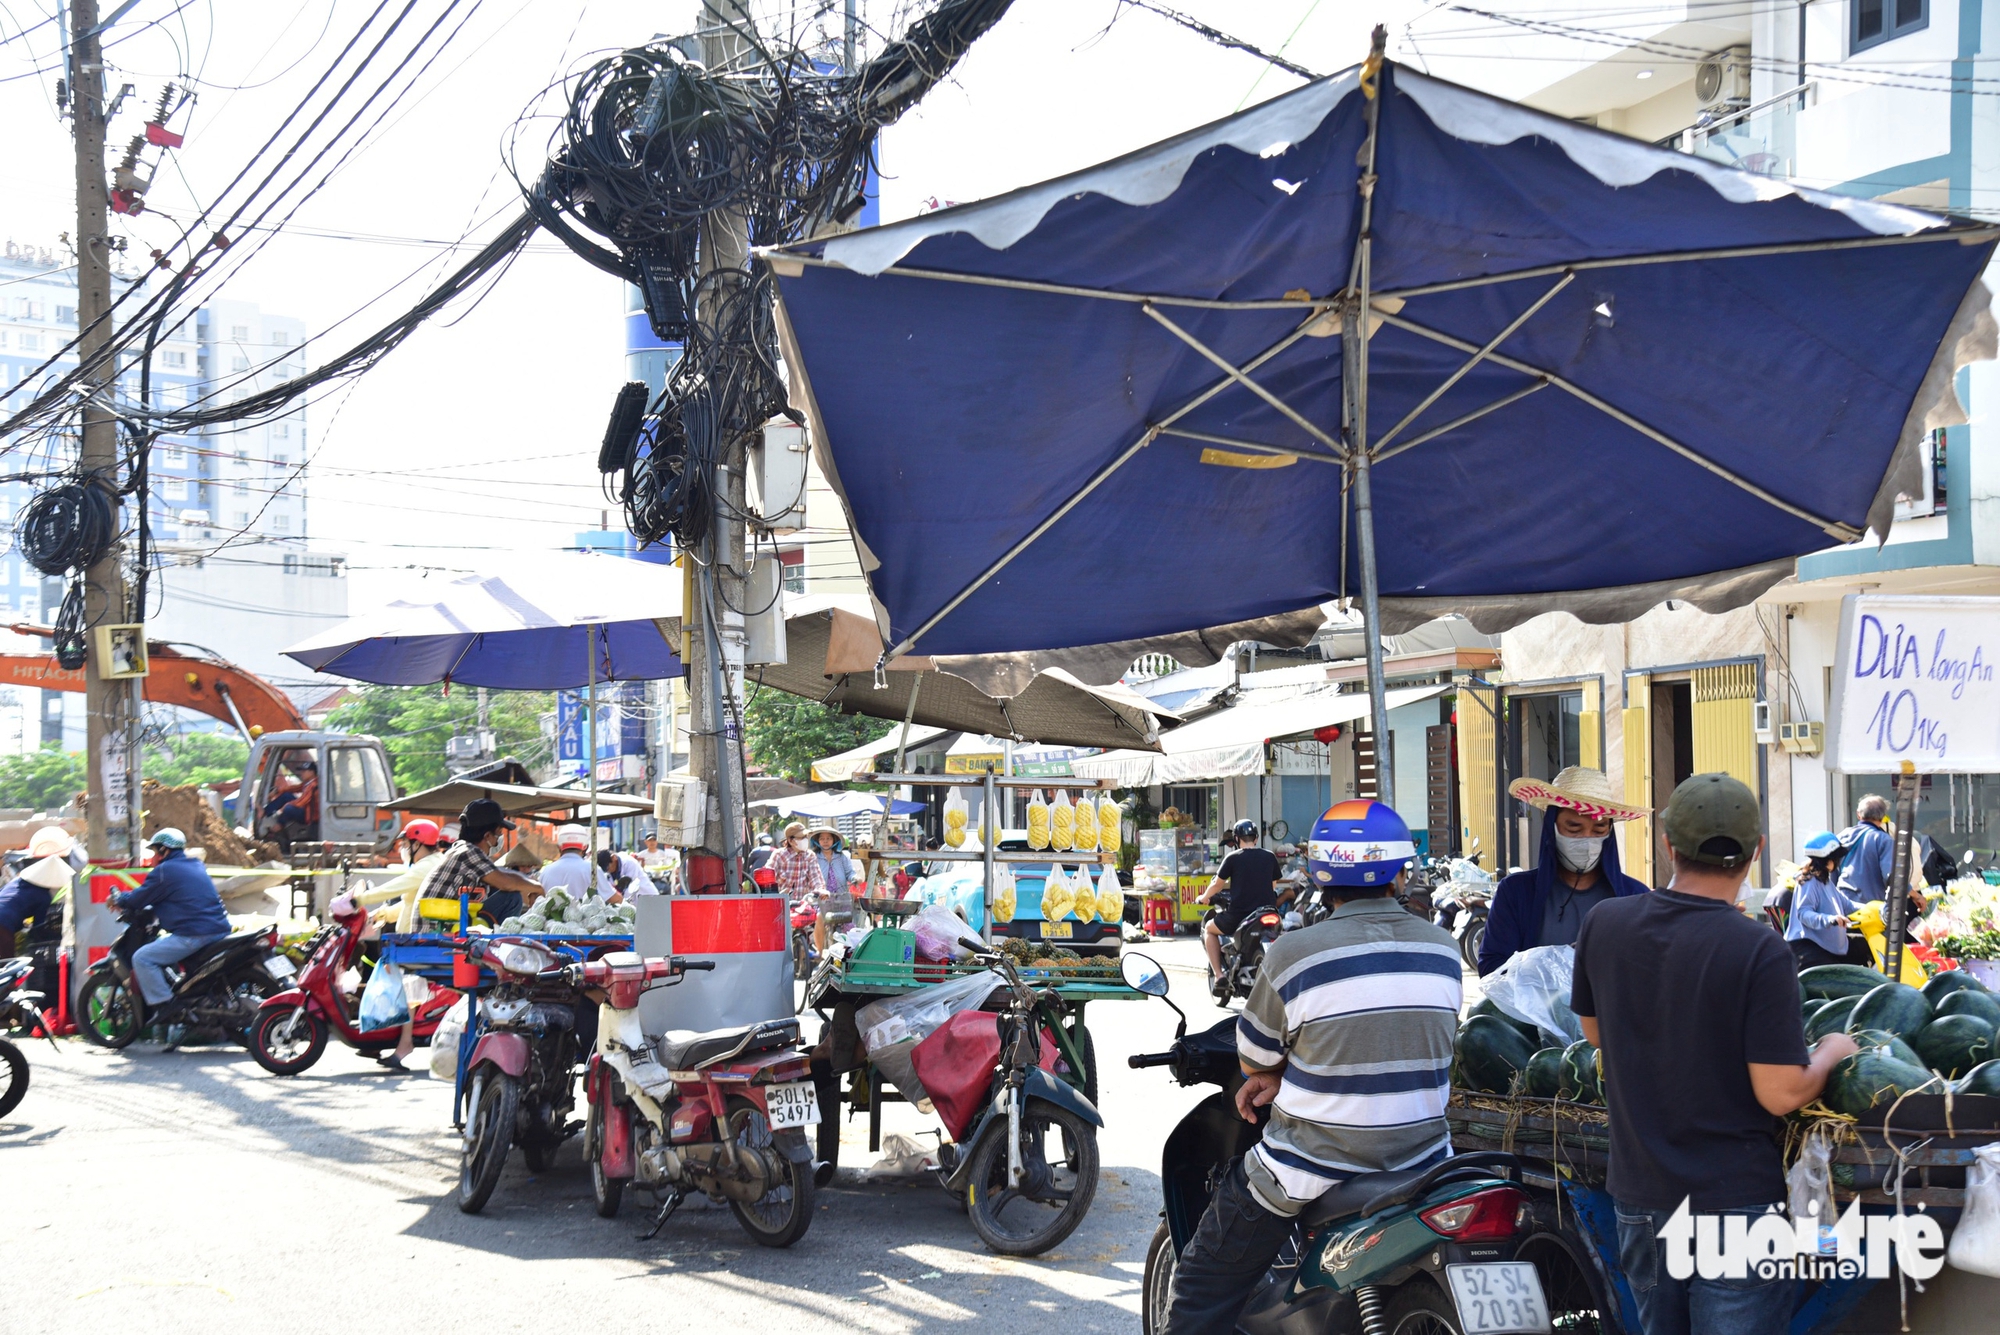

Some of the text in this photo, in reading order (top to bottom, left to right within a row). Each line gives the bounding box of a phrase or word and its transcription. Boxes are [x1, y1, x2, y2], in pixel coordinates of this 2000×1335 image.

[1866, 689, 1918, 754] 10
[1324, 844, 1355, 862] Vikki
[756, 1029, 785, 1040] HONDA
[775, 1086, 808, 1105] 50L1
[776, 1104, 812, 1123] 5497
[1472, 1298, 1539, 1329] 2035
